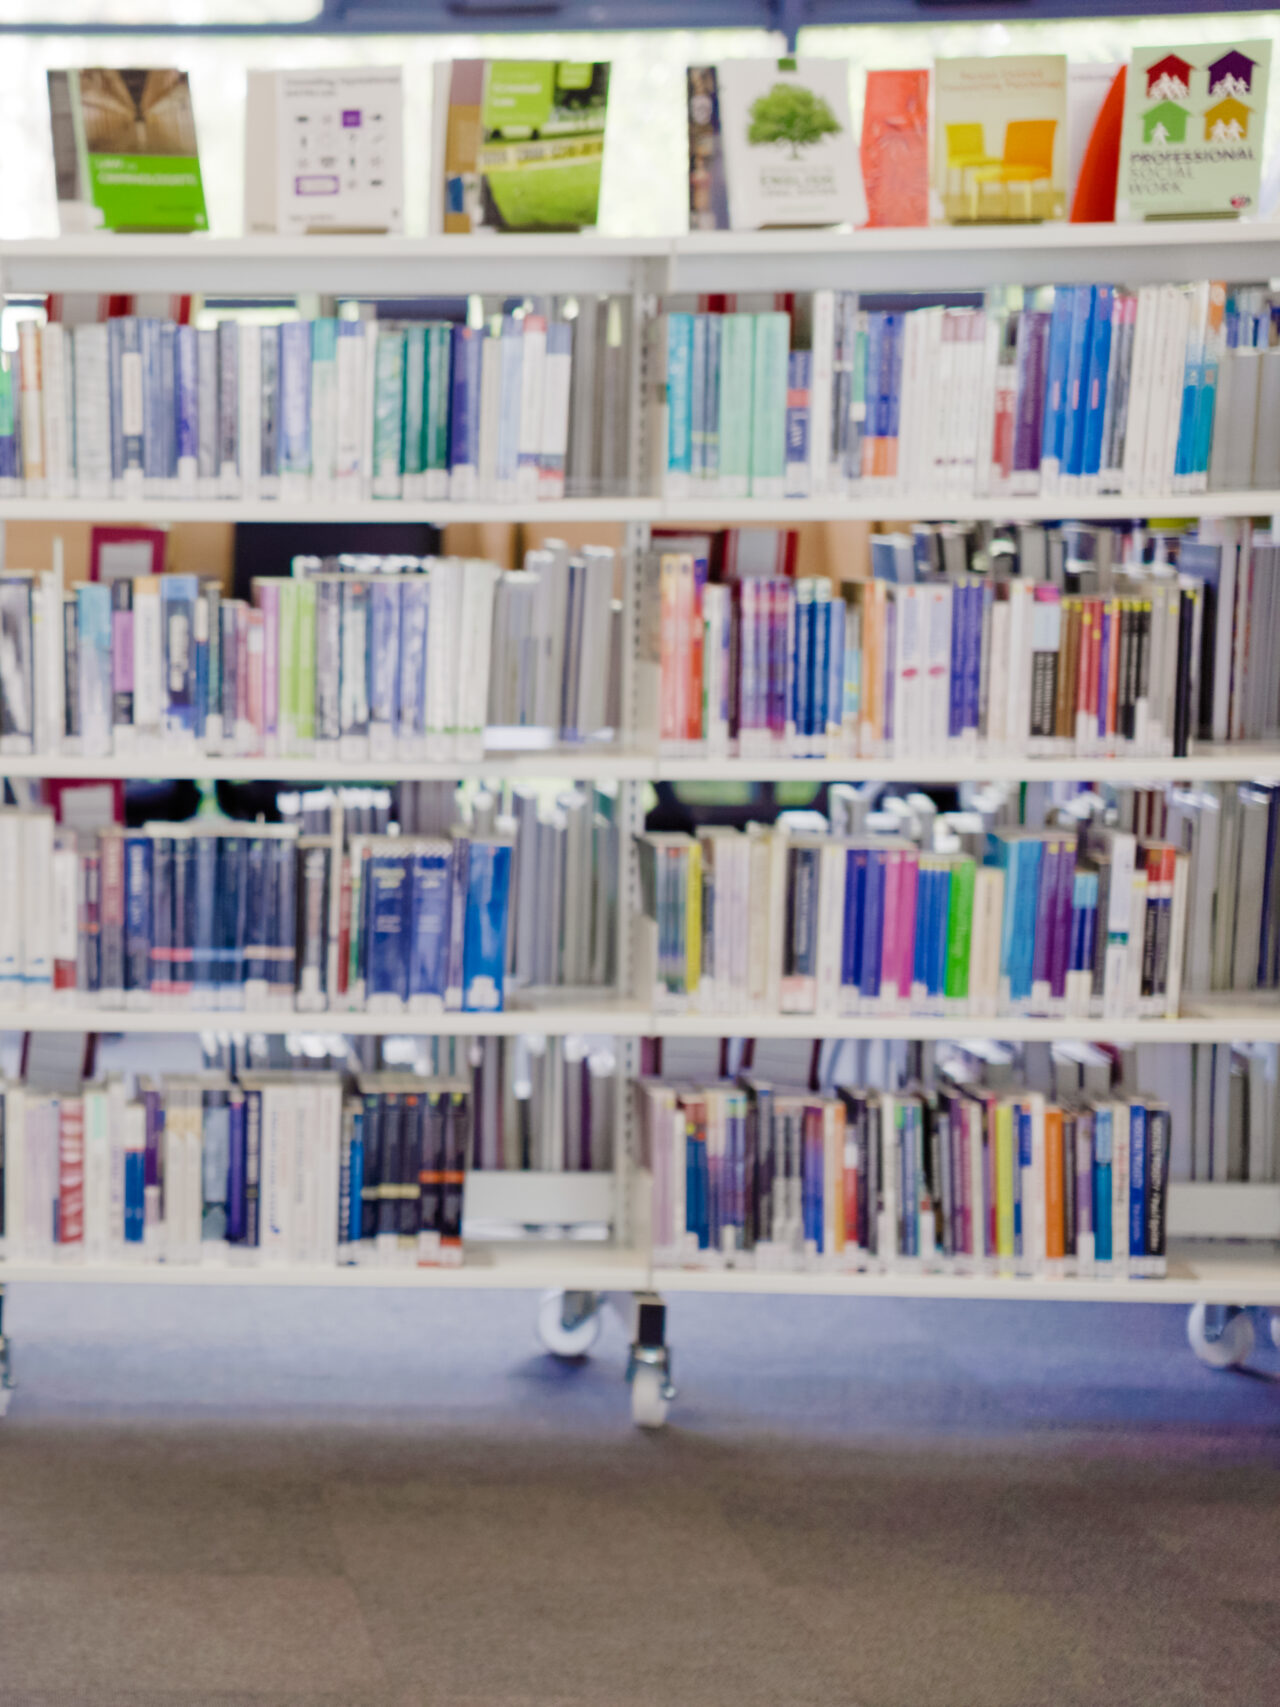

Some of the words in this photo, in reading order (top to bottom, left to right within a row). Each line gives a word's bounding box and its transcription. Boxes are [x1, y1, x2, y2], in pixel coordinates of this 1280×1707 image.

[1130, 148, 1256, 164] PROFESSIONAL
[1130, 165, 1194, 180] SOCIAL
[1129, 181, 1183, 195] WORK
